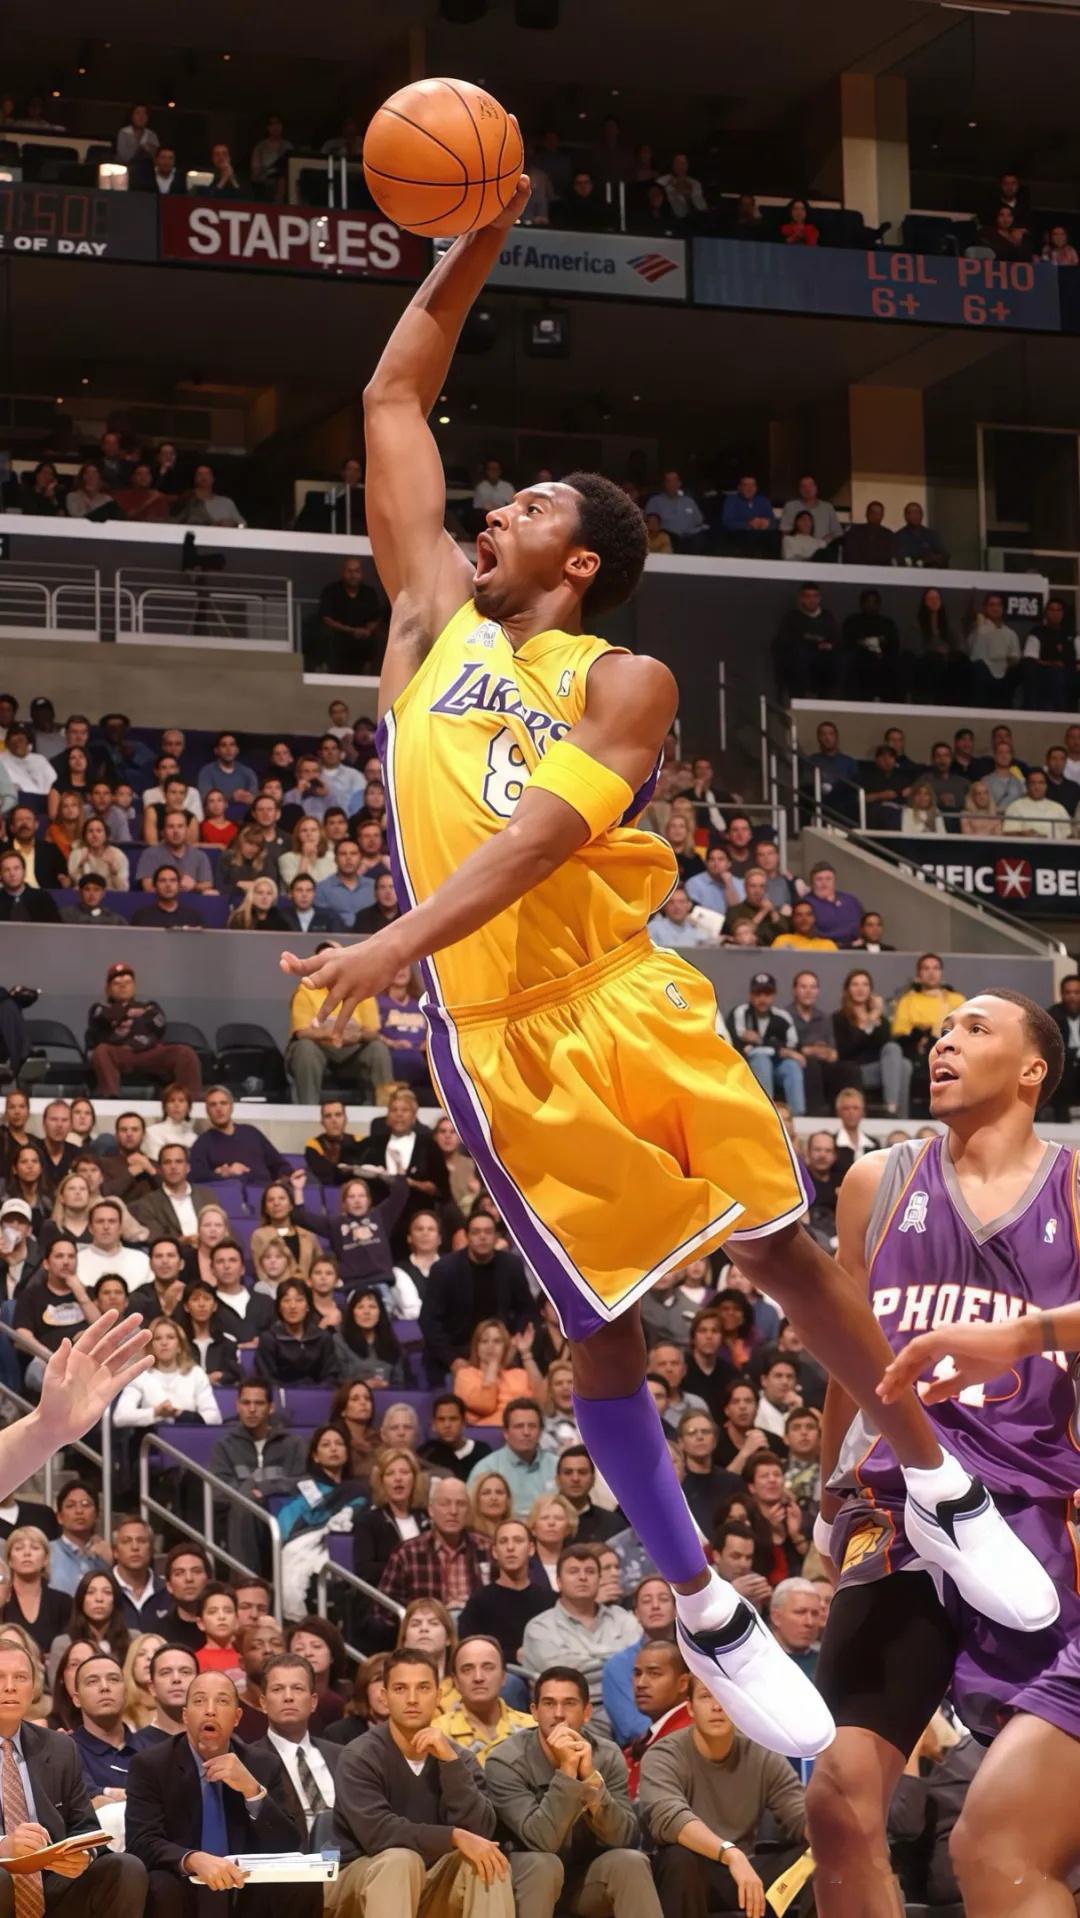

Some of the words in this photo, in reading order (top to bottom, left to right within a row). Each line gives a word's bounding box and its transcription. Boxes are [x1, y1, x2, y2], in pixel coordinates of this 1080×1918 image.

[14, 236, 48, 251] OF
[57, 239, 107, 256] DAY
[188, 208, 400, 269] STAPLES
[500, 244, 523, 267] of
[524, 246, 616, 275] America
[866, 252, 937, 285] LAL
[957, 256, 1034, 292] PHO
[871, 287, 920, 318] 6+
[963, 294, 1010, 324] 6+
[484, 726, 532, 818] 8
[899, 863, 994, 893] CIFIC
[1036, 868, 1080, 896] BE
